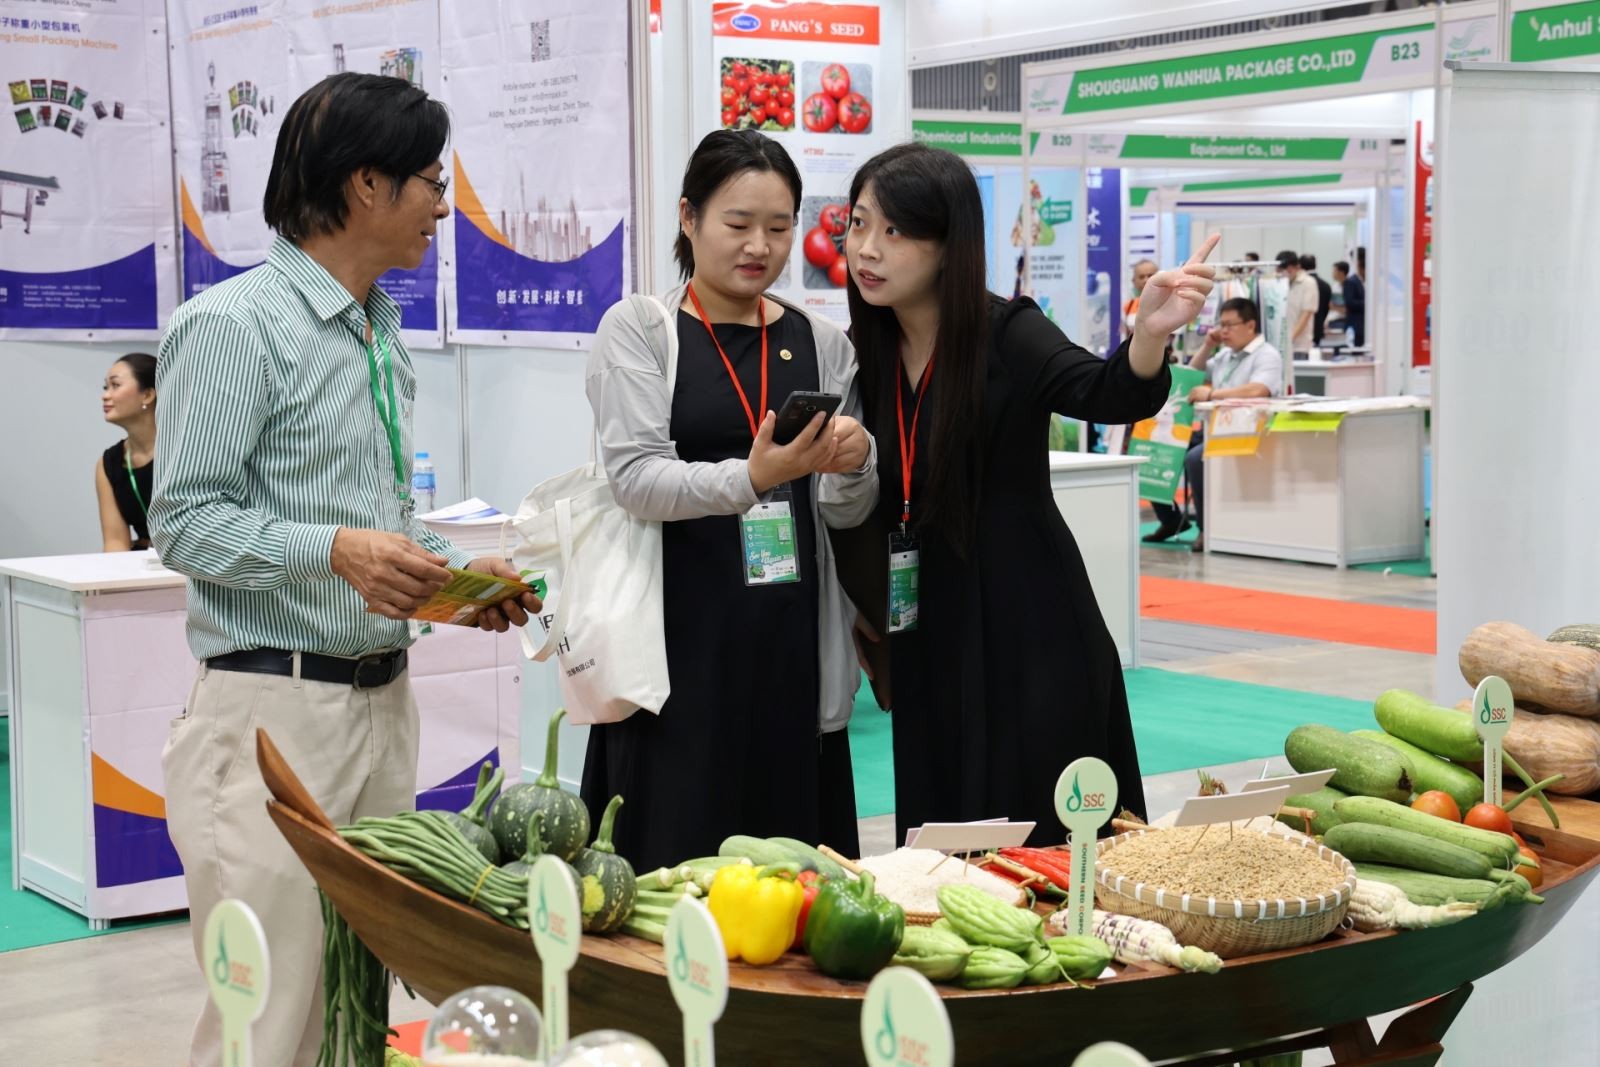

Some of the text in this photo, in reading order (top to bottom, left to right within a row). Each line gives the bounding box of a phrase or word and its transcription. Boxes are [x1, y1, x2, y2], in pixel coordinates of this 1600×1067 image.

[770, 19, 865, 36] PANG'S SEED
[1537, 16, 1593, 42] Anhui
[14, 34, 40, 43] Small
[42, 36, 80, 48] Packing
[81, 39, 118, 50] Machine
[1391, 42, 1420, 61] B23
[1078, 49, 1356, 98] SHOUGUANG WANHUA PACKAGE CO.,LTD
[912, 130, 967, 143] Chemical
[1053, 135, 1072, 146] B20
[1190, 143, 1243, 156] Equipment
[1270, 145, 1286, 155] Ltd
[1492, 707, 1506, 720] SSC
[1083, 793, 1105, 808] SSC
[1080, 843, 1088, 884] SOUTHERN
